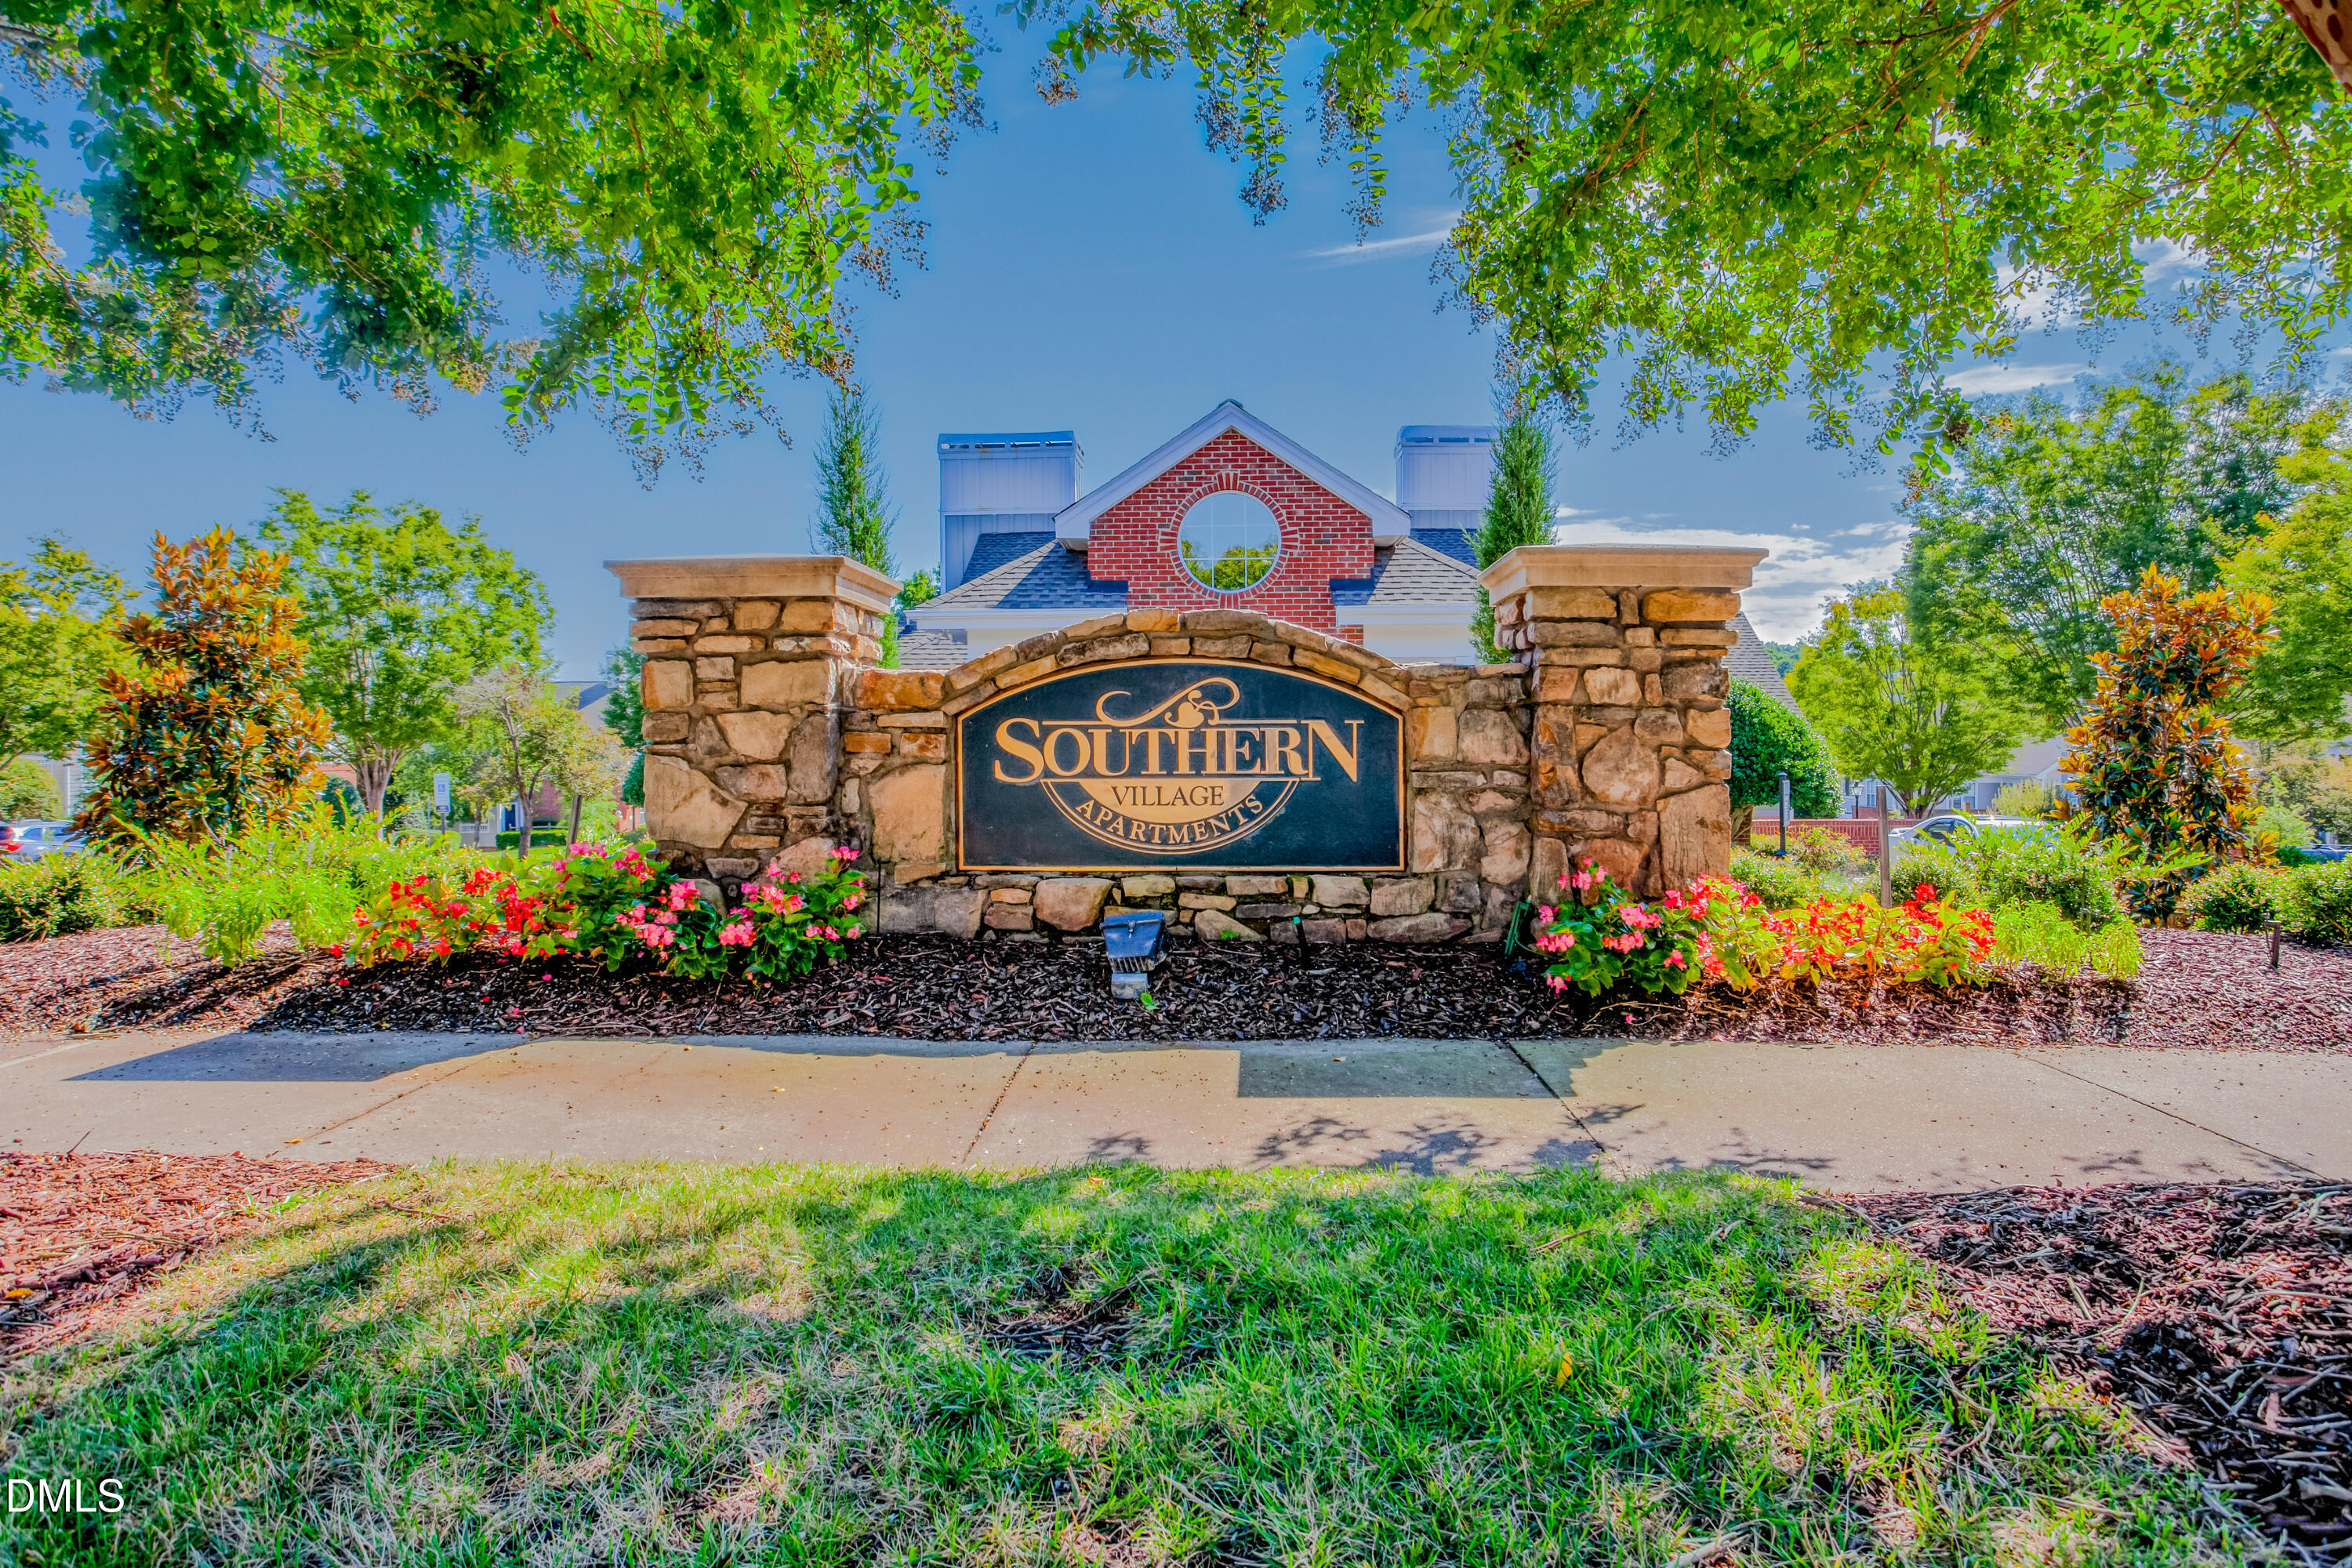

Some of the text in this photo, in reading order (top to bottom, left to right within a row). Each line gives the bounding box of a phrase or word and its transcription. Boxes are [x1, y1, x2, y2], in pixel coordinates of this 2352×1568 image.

[994, 718, 1364, 782] SOUTHERN
[1076, 796, 1264, 844] APARTMENTS
[1112, 786, 1225, 806] VILLAGE
